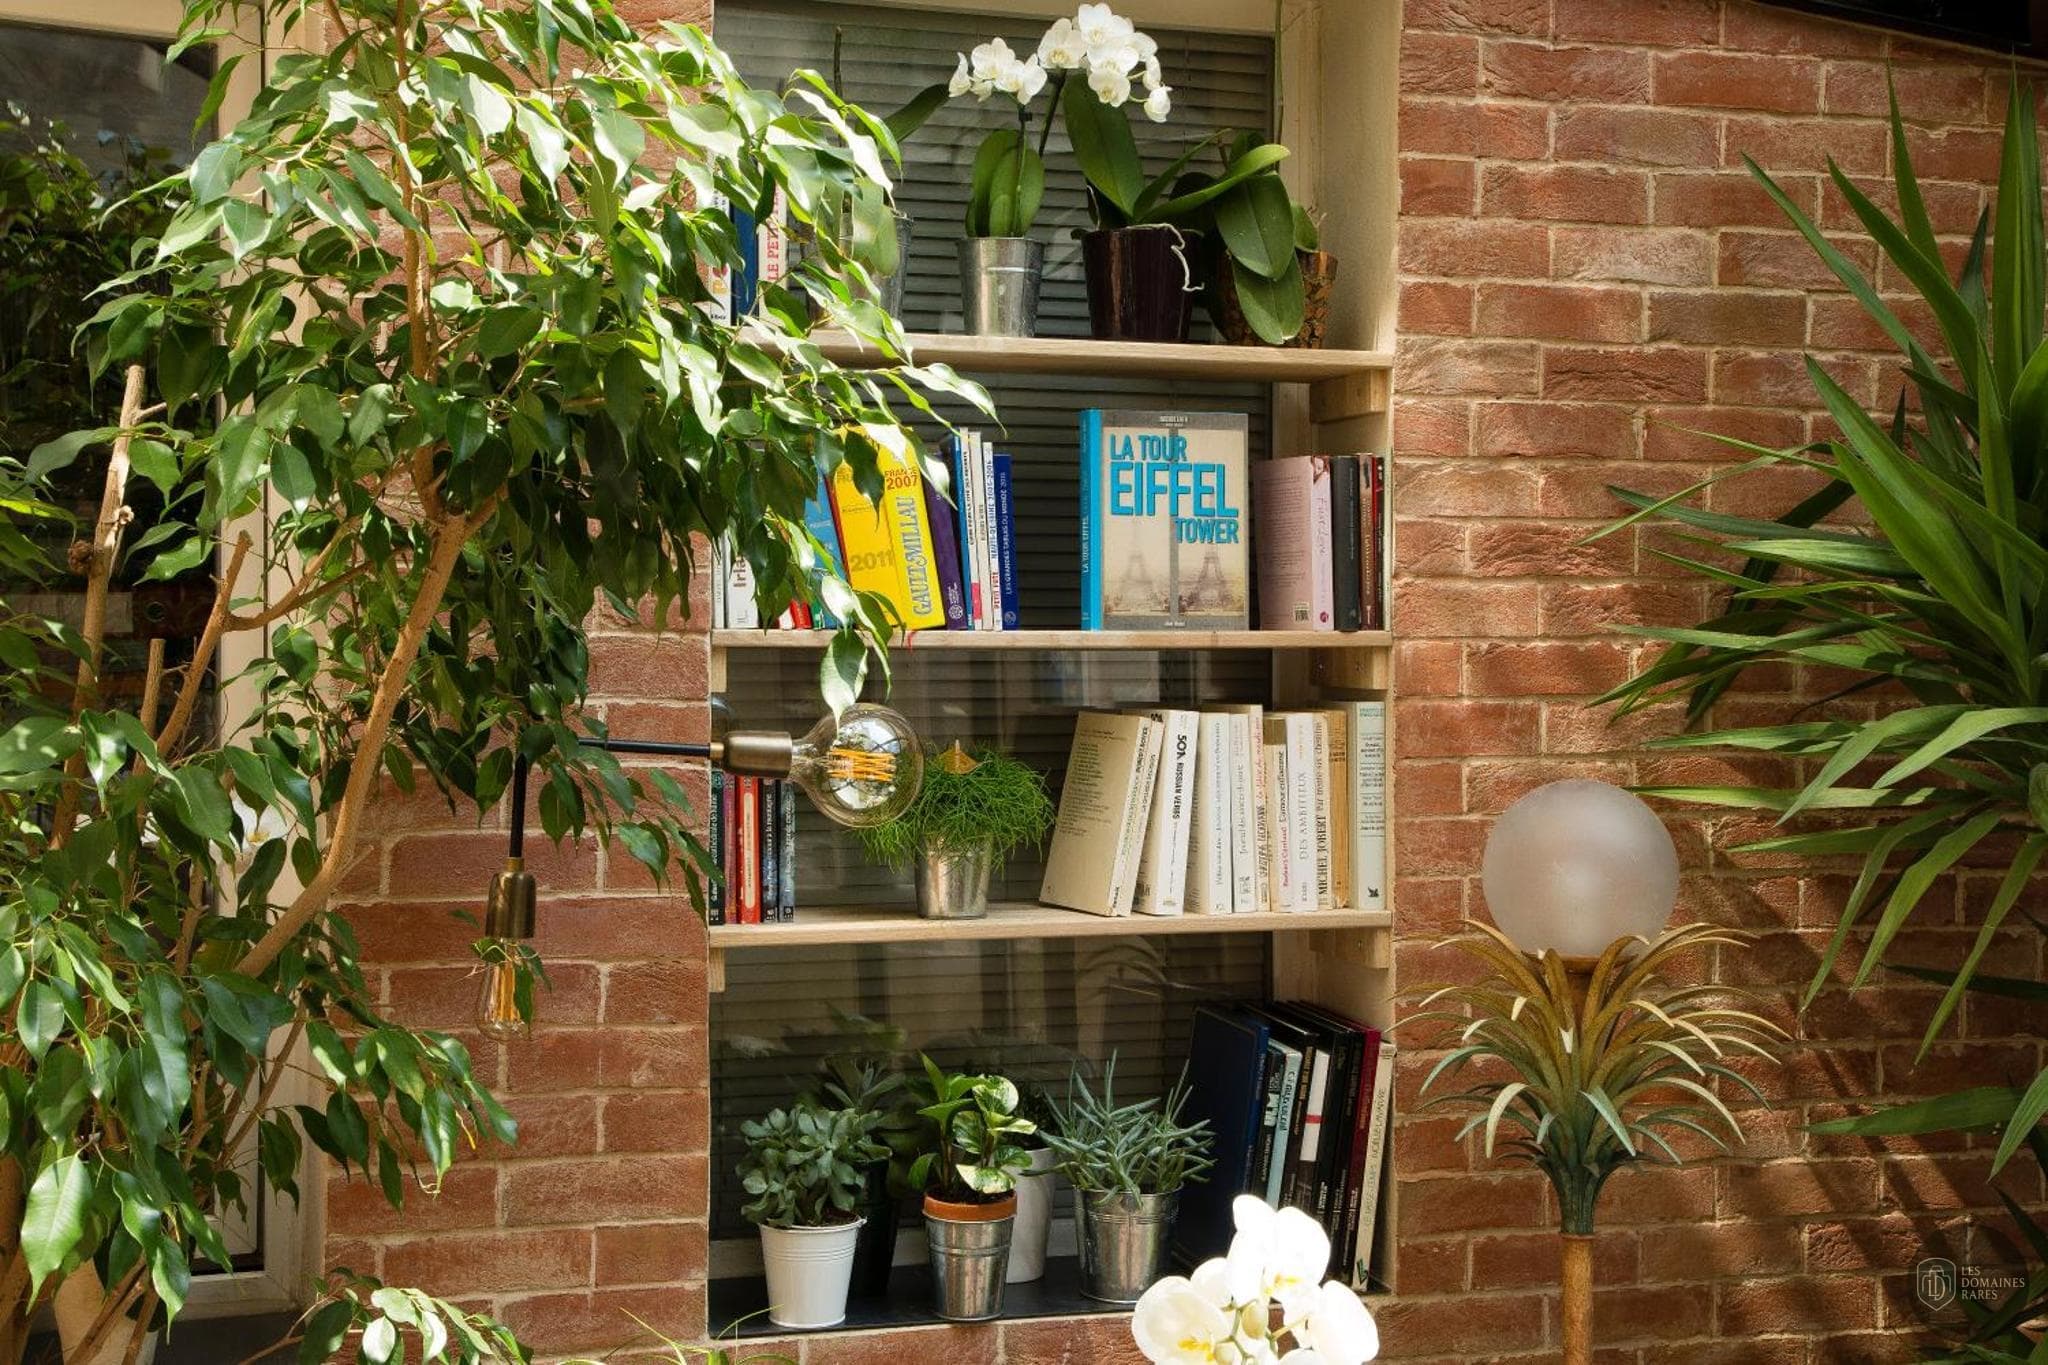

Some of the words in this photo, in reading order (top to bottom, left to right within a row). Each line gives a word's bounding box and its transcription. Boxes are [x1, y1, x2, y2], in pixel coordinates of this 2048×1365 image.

[1110, 434, 1134, 461] LA
[1138, 434, 1188, 462] TOUR
[886, 475, 918, 491] 2007
[1110, 461, 1239, 518] EIFFEL
[1174, 518, 1239, 545] TOWER
[850, 549, 894, 572] 2011
[1174, 762, 1184, 794] RUSSIAN
[1172, 796, 1182, 819] VERBS
[1298, 772, 1308, 835] AMBITIEUX
[1316, 814, 1329, 853] JOBERT
[1299, 839, 1309, 859] DES
[1317, 855, 1328, 895] MICHEL
